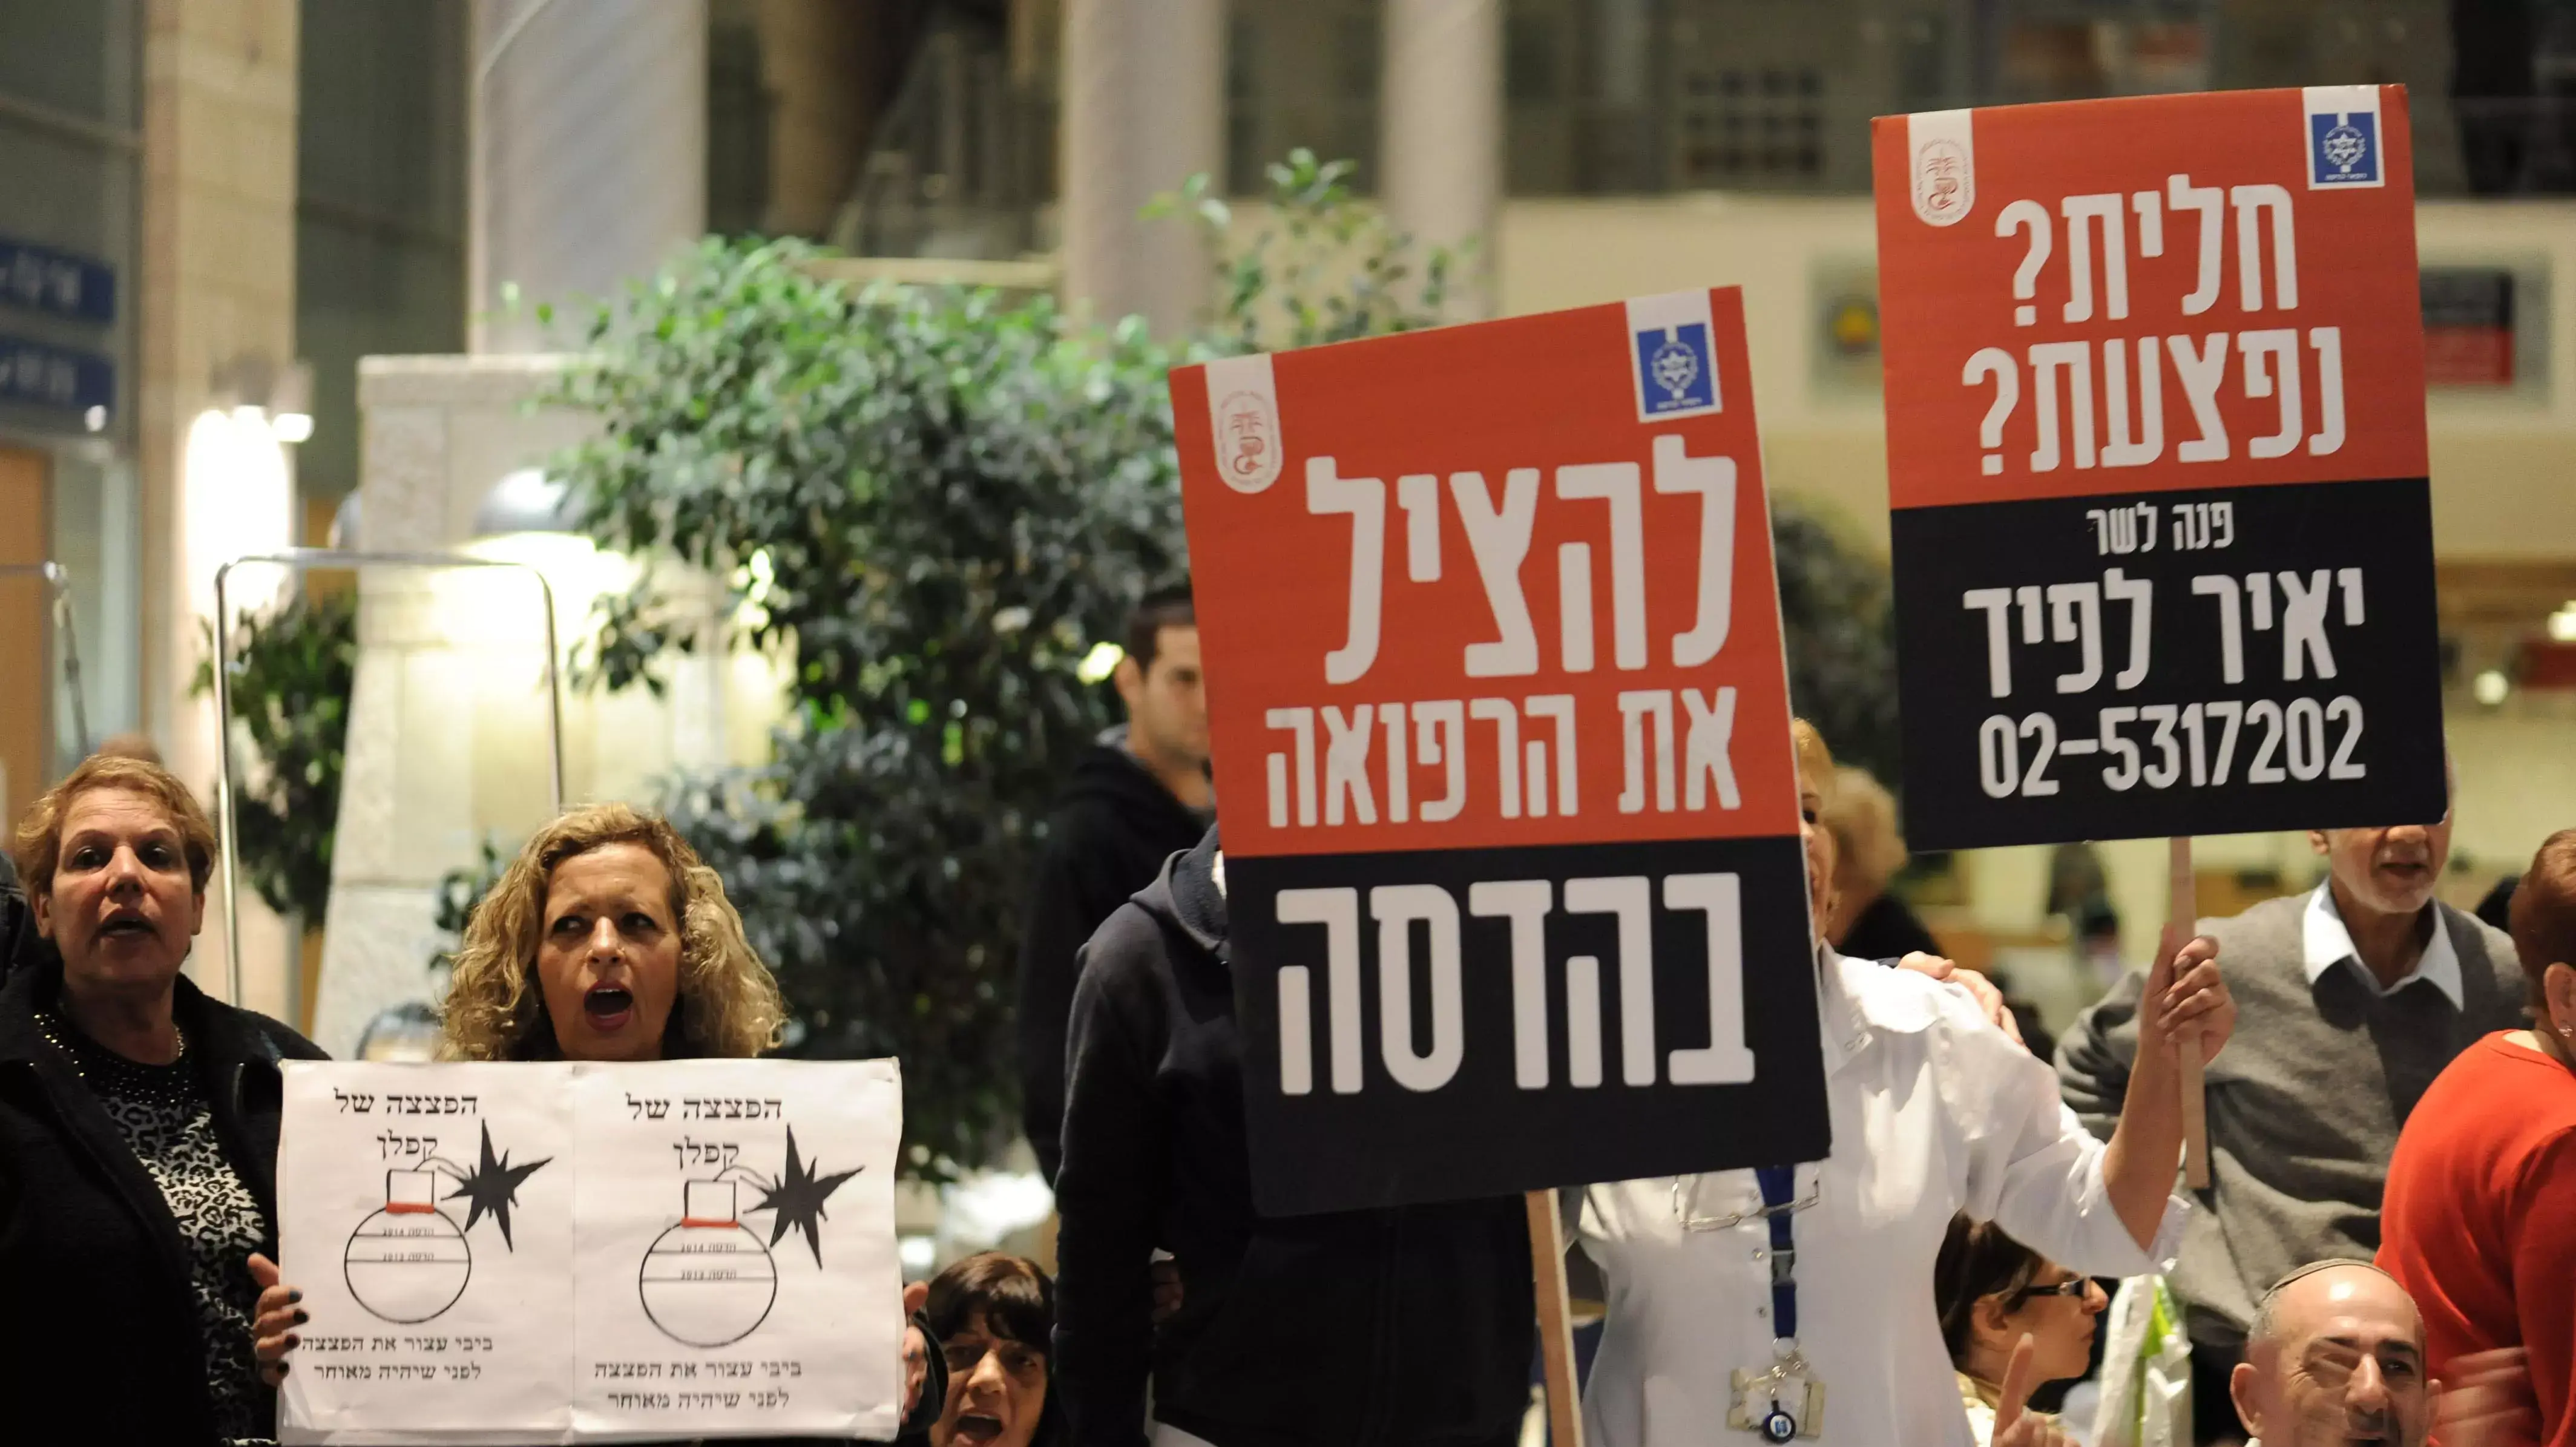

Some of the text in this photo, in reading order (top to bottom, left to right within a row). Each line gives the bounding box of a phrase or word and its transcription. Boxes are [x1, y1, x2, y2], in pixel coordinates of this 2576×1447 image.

[1995, 173, 2299, 327] חלית?
[1962, 326, 2347, 476] נפצעת?
[2086, 501, 2234, 555] פנה לשר
[1306, 434, 1738, 685] להציל
[1963, 568, 2365, 698] יאיר לפיד
[1266, 686, 1741, 828] את הרפואה
[1979, 695, 2366, 799] 02-5317202
[1276, 872, 1755, 1095] בהדסה
[334, 1087, 478, 1115] הפצצה של
[625, 1092, 782, 1121] הפצצה של
[376, 1129, 438, 1158] קפלן
[672, 1135, 740, 1170] קפלן
[302, 1337, 493, 1353] ביבי עצור את הפצצה
[314, 1362, 481, 1380] לפני שיהיה מאוחר
[595, 1361, 802, 1378] ביבי עצור את הפצצה
[607, 1386, 789, 1409] לפני שיהיה מאוחר
